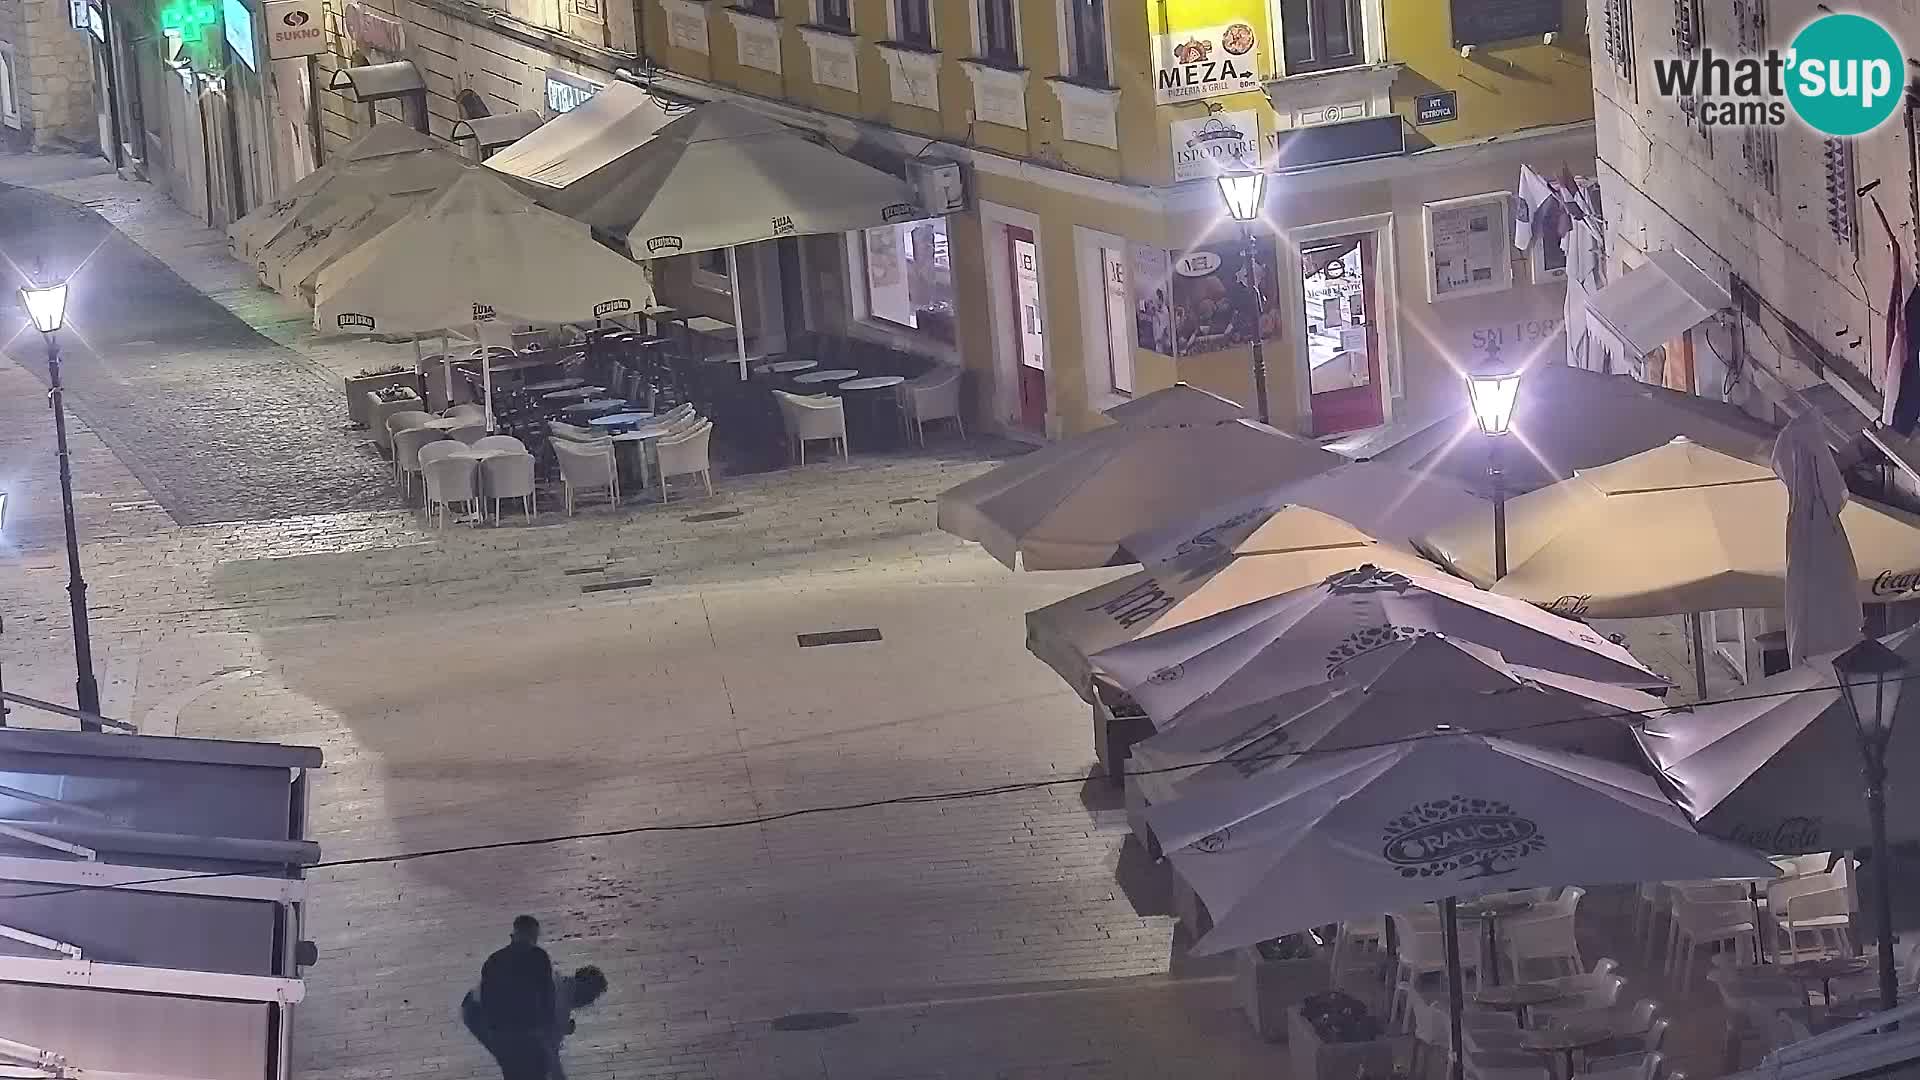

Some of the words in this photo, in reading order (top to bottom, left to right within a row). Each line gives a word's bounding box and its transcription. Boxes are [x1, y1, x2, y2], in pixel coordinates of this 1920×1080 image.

[275, 28, 320, 41] SUKNO
[1159, 60, 1237, 90] MEZA
[1168, 87, 1200, 97] PIZZERIA
[1201, 85, 1208, 93] &
[1208, 82, 1229, 92] GRILL
[1177, 145, 1223, 163] ISPOD
